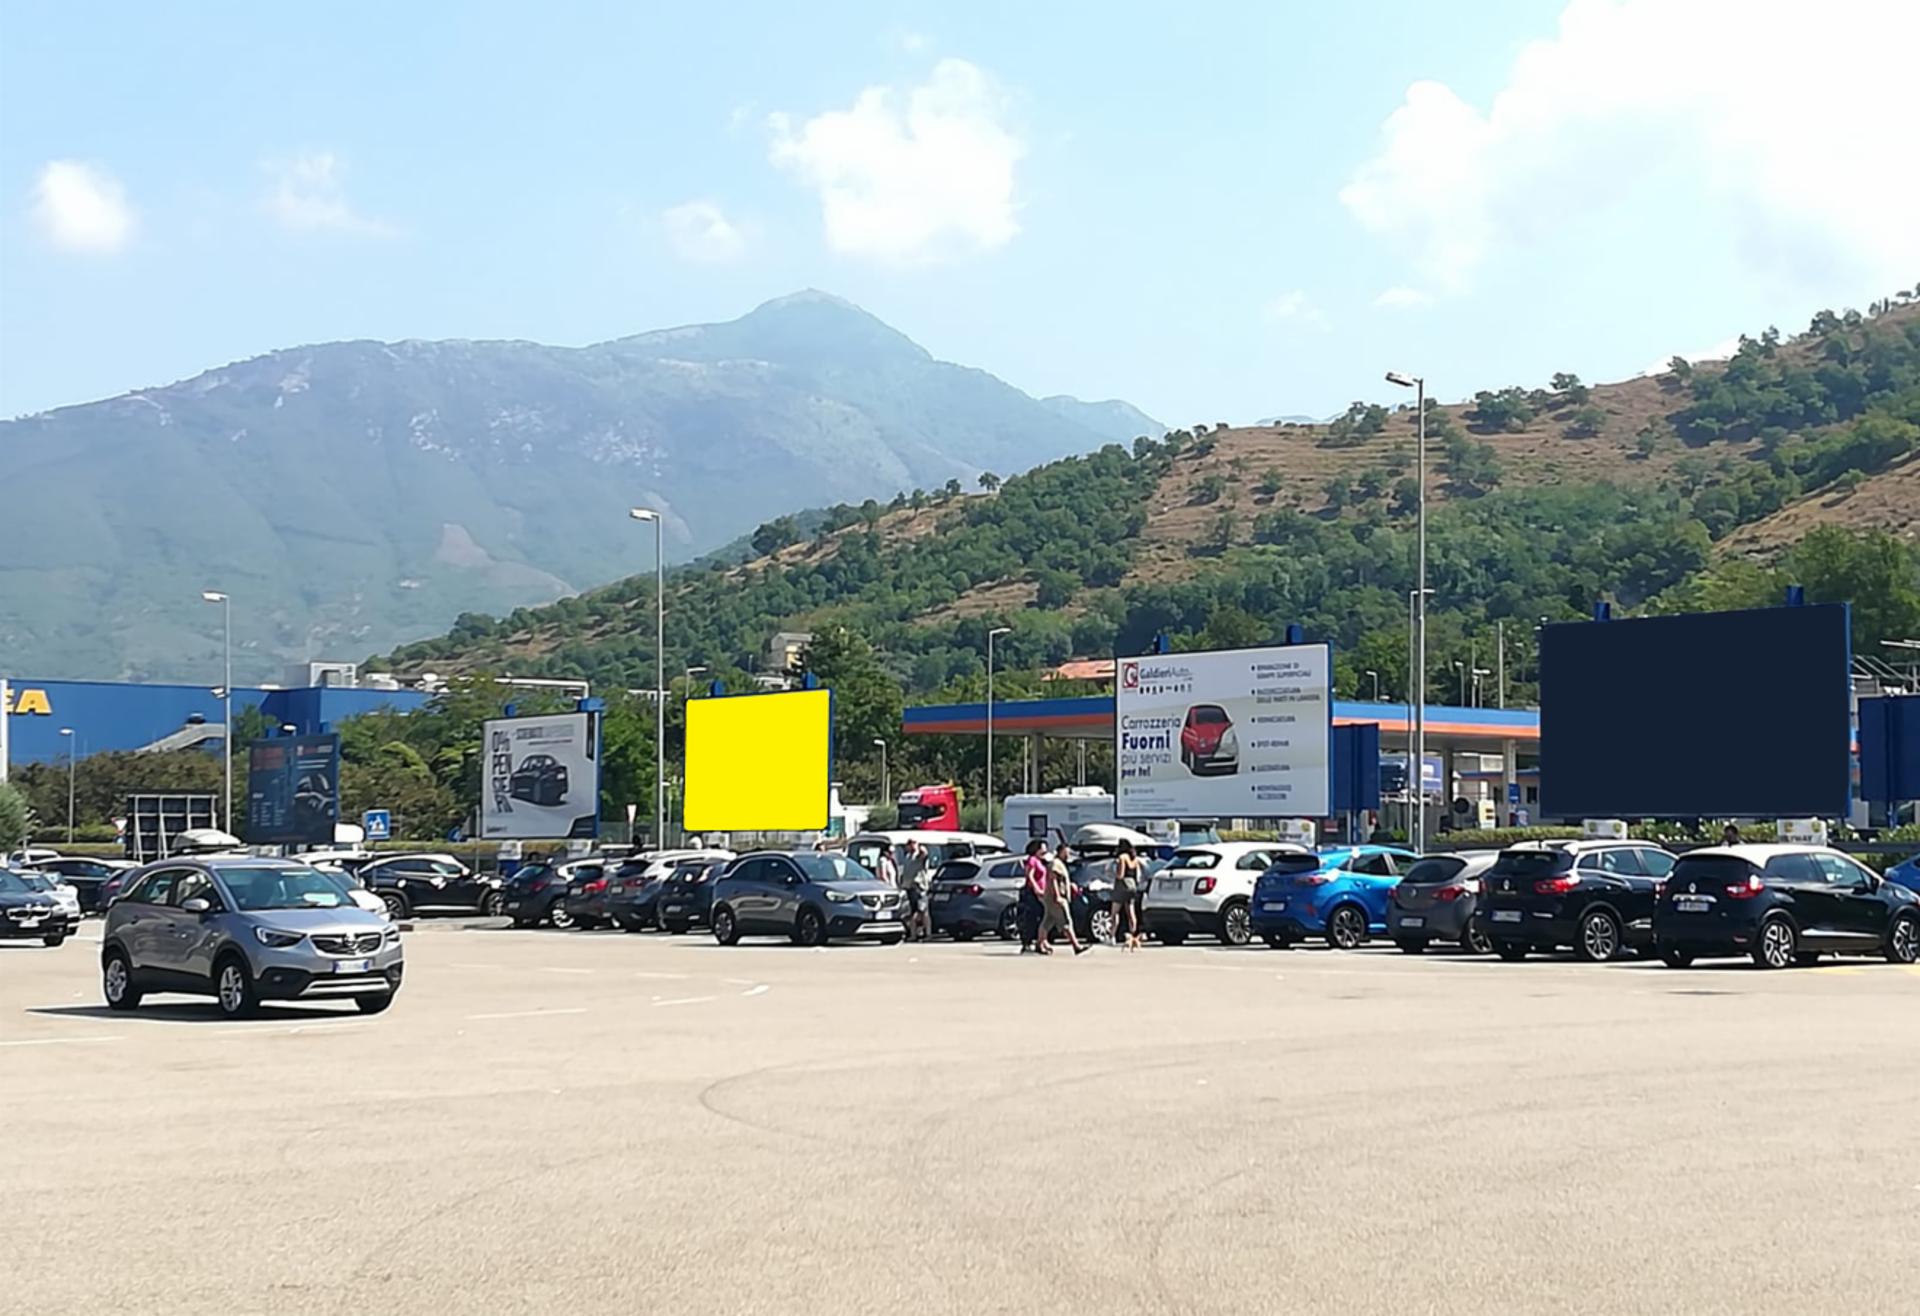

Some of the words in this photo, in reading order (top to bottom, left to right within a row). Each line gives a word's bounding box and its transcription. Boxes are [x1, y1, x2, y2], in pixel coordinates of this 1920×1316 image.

[1121, 712, 1182, 730] Carrozzeria
[1122, 729, 1170, 750] Fuorni
[1121, 768, 1136, 780] per
